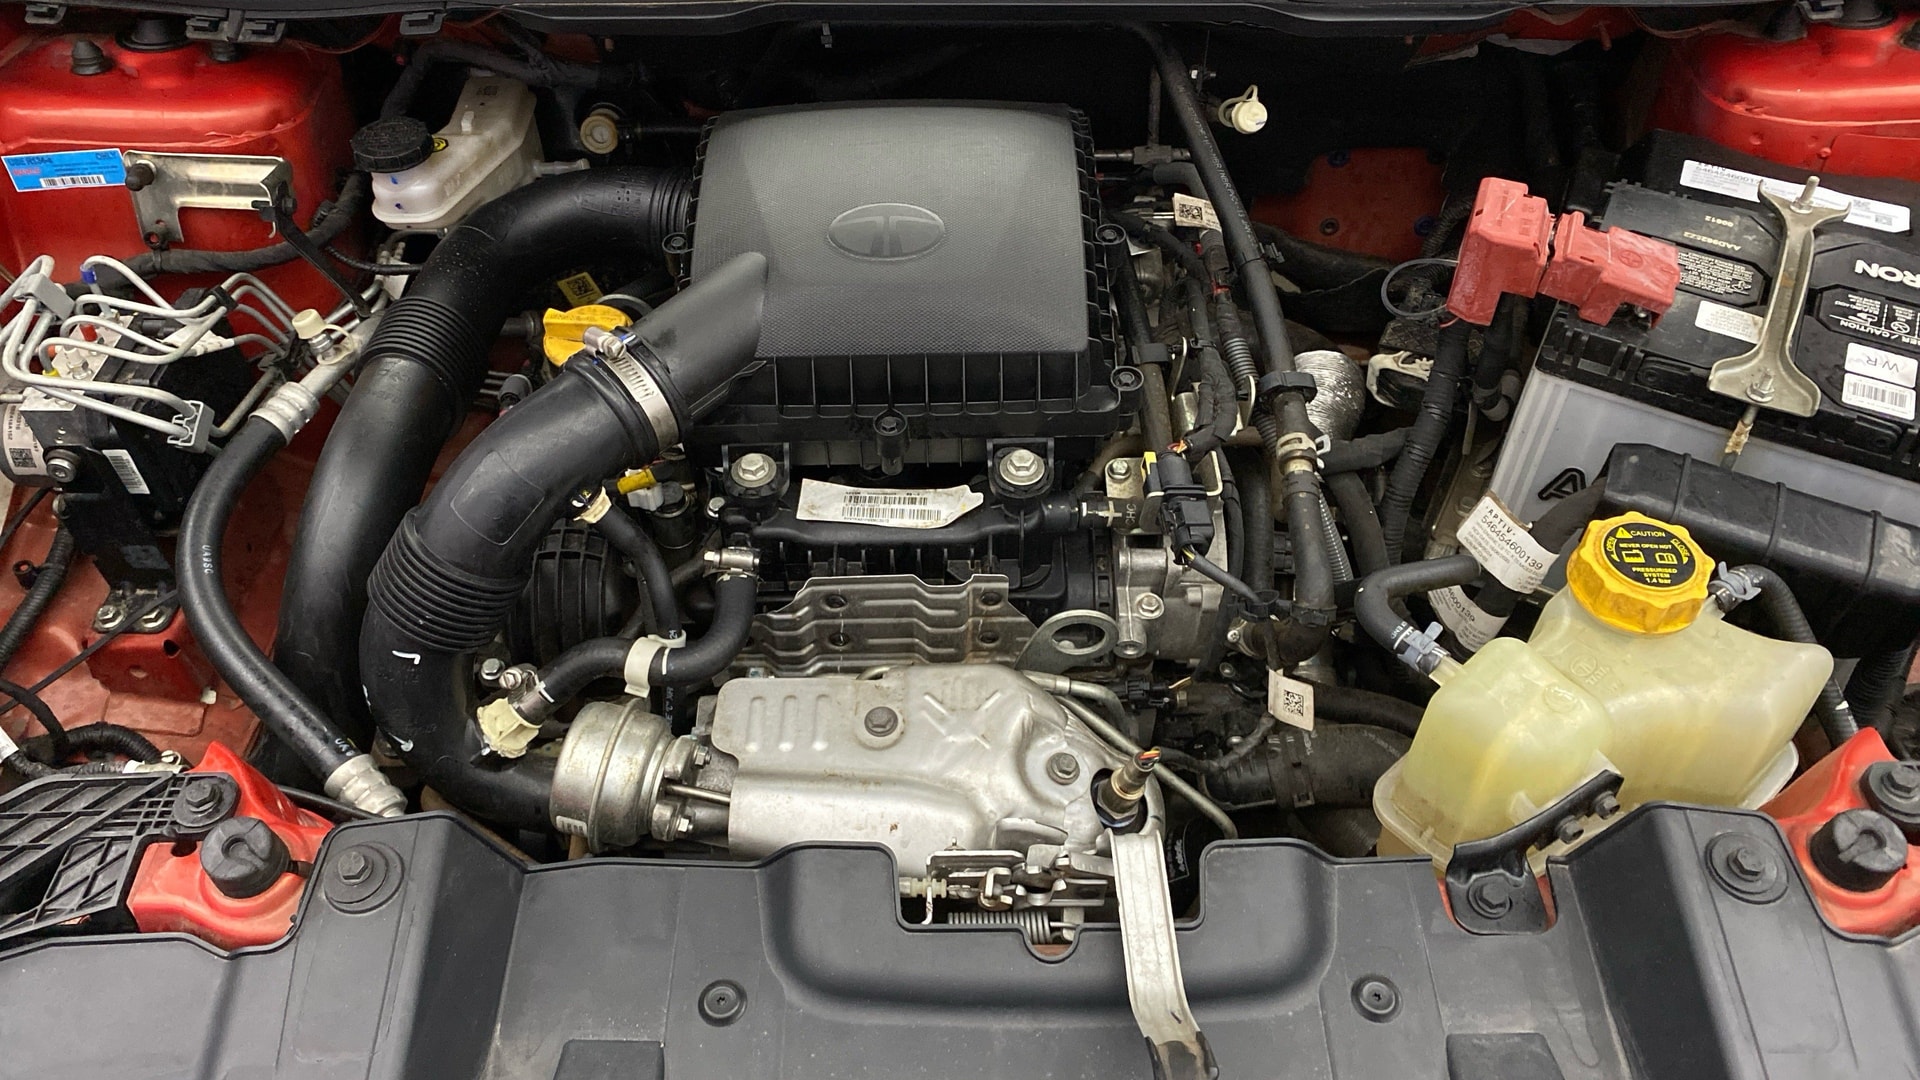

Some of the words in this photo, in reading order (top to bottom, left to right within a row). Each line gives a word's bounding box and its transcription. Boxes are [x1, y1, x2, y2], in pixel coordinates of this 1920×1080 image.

[1840, 320, 1891, 340] CAUTION
[1125, 503, 1136, 525] CHC
[1487, 508, 1513, 532] APTIV
[1481, 515, 1544, 571] 546454600139
[1672, 538, 1690, 558] CLOSE
